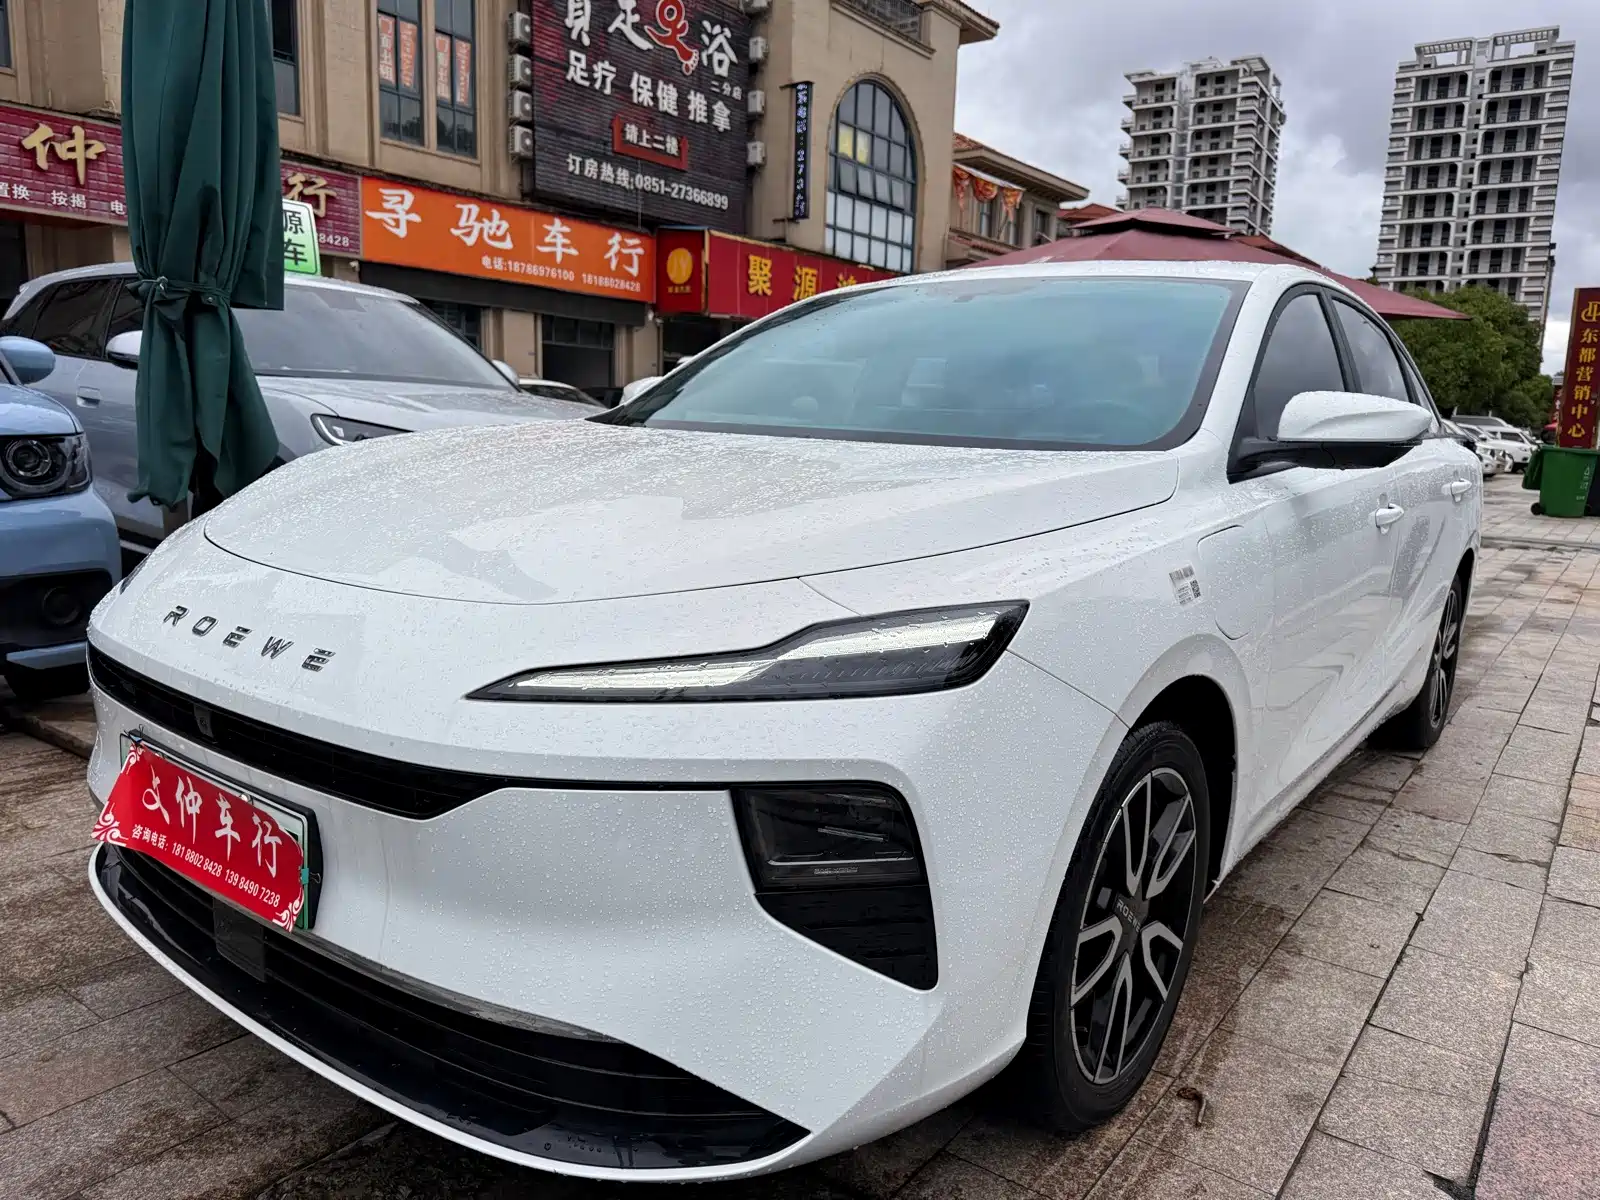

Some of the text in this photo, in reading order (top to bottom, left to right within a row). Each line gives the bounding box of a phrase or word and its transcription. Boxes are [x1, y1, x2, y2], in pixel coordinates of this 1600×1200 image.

[566, 50, 731, 132] 足疗 保健 推拿
[710, 80, 743, 100] 二分店
[623, 123, 680, 157] 请上二楼
[51, 190, 87, 209] 按揭
[364, 187, 645, 278] 寻驰车行
[1567, 328, 1600, 438] 东都营销中心
[163, 605, 336, 673] ROEWE
[1116, 899, 1141, 933] ROEWE
